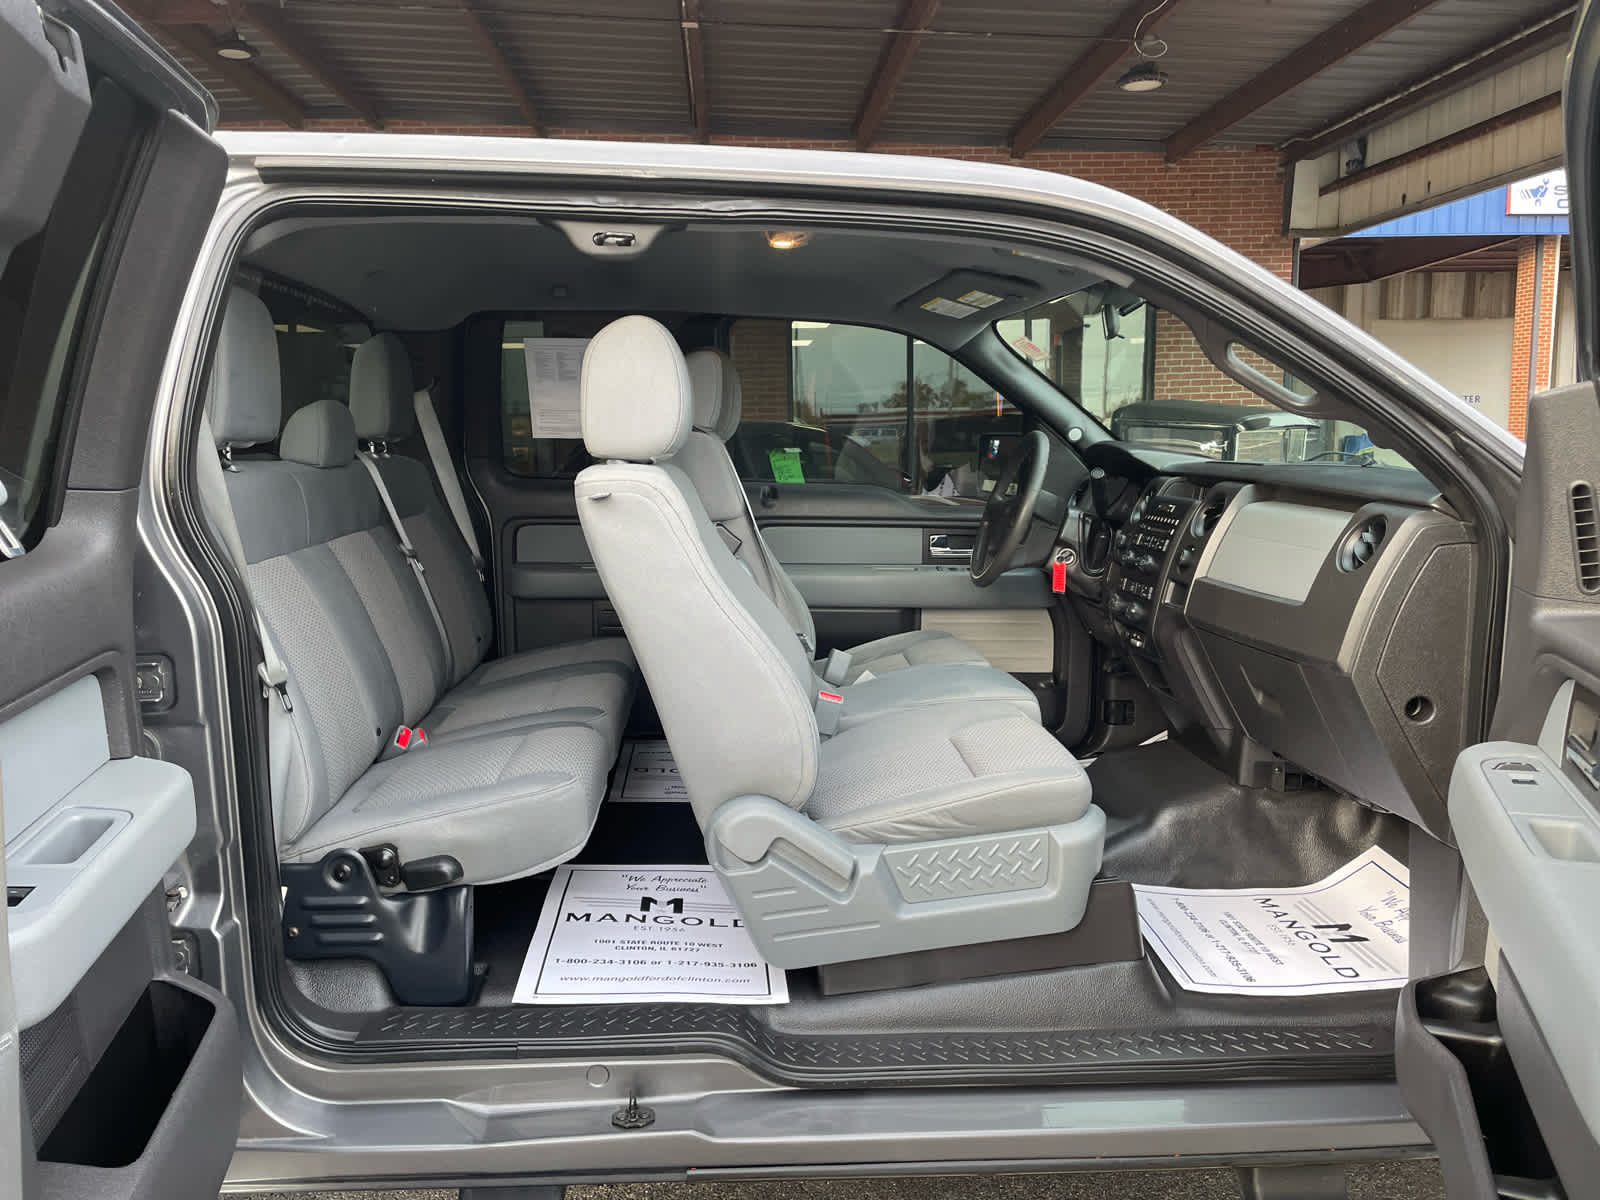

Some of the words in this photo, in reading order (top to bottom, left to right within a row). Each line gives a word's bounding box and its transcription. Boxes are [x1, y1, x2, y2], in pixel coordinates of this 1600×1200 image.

[1253, 898, 1360, 978] MANGOLD
[555, 957, 647, 966] 1-800-234-3106
[667, 959, 758, 968] 1-217-935-3106
